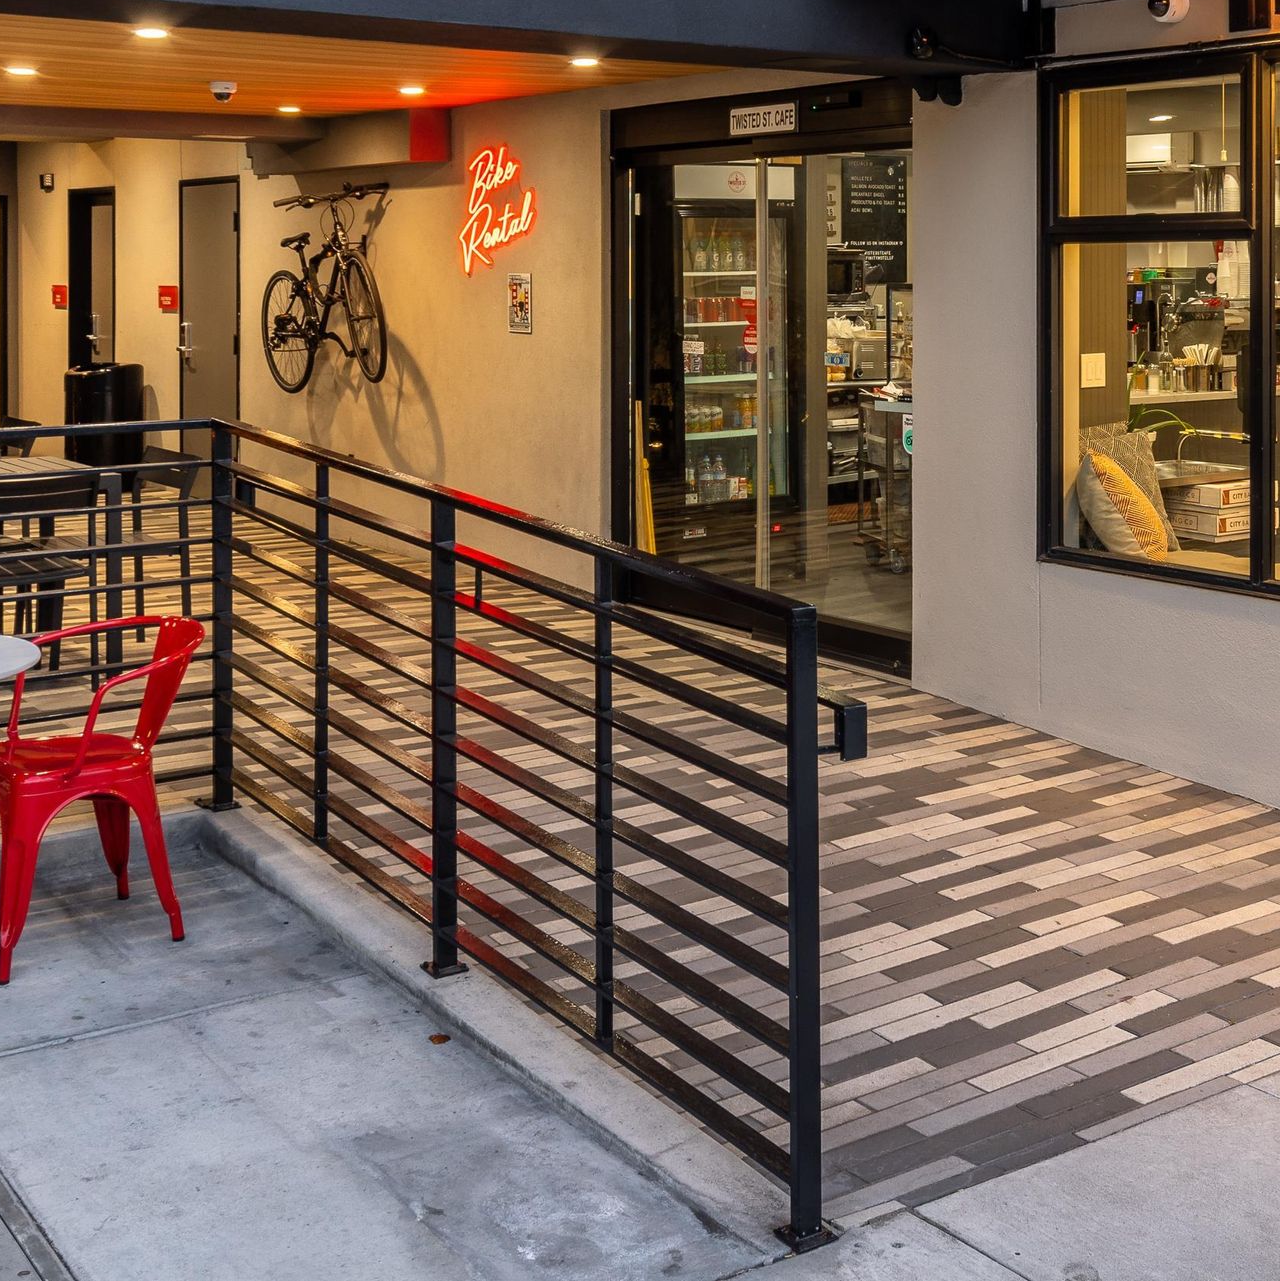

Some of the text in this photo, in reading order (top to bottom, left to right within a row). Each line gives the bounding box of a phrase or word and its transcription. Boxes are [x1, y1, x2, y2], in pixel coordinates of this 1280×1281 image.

[732, 108, 794, 131] TWISTED ST. CAFE
[468, 146, 519, 215] Bike
[459, 191, 534, 274] Rental
